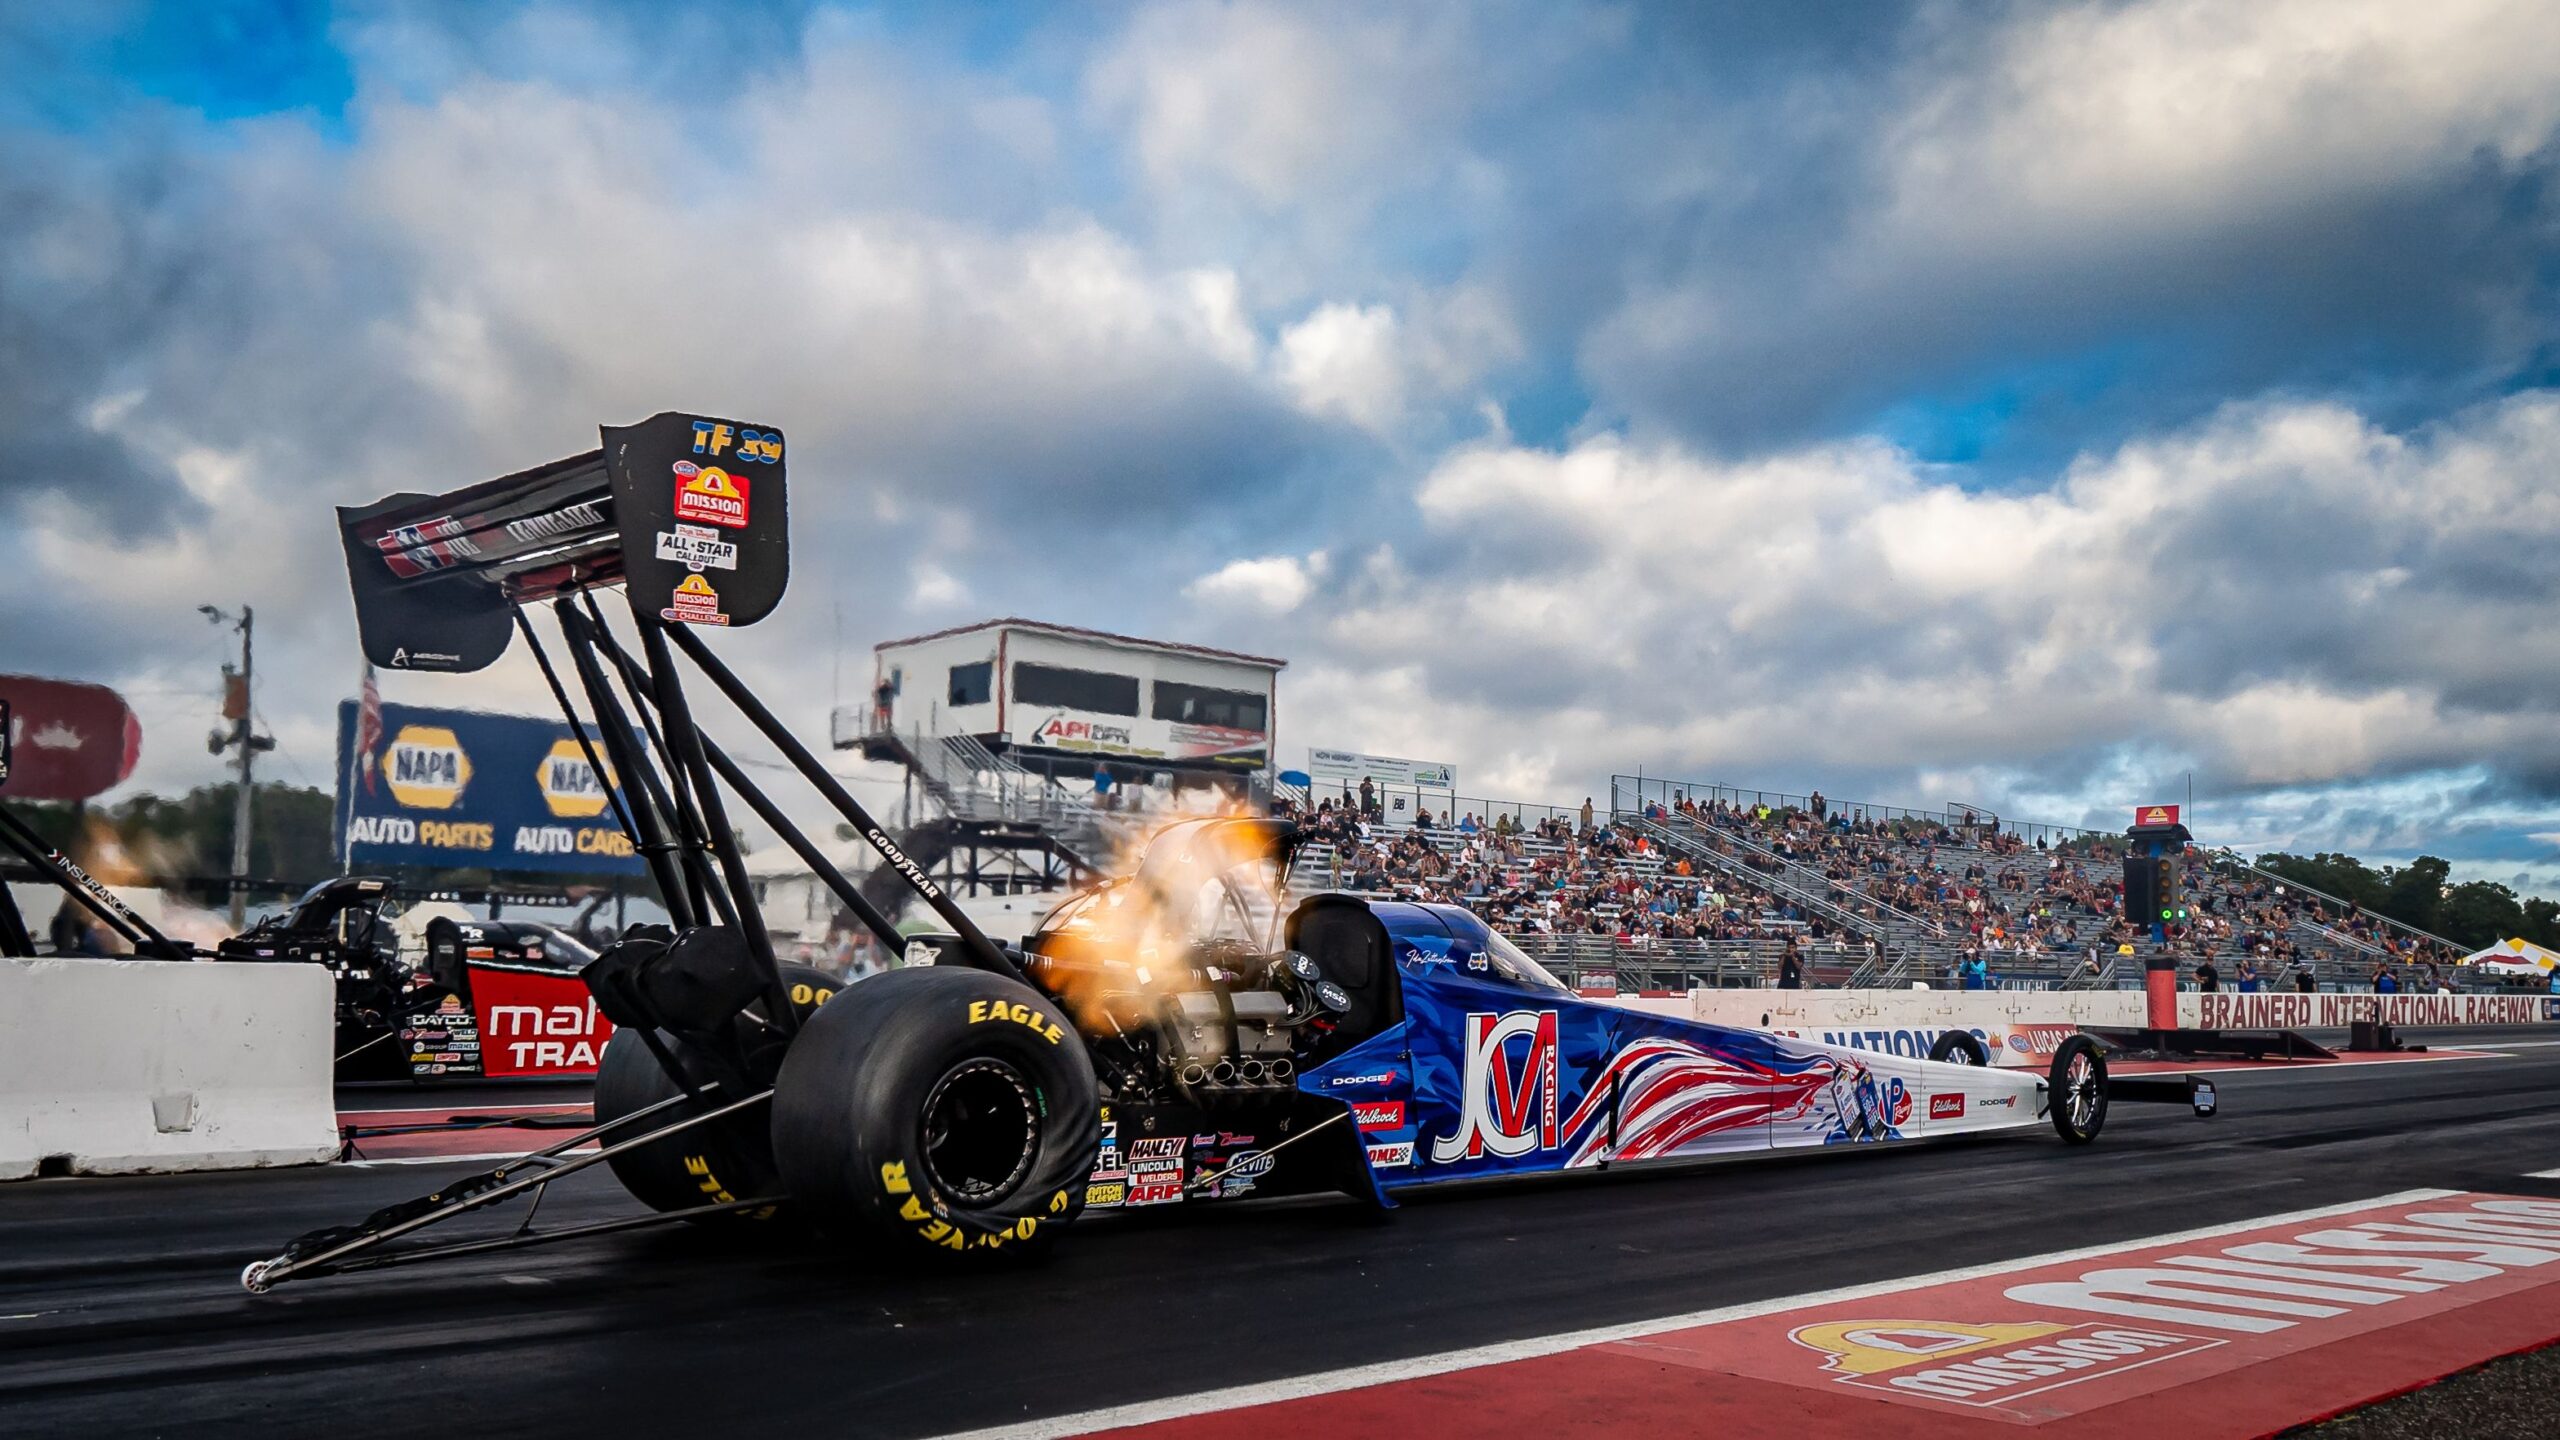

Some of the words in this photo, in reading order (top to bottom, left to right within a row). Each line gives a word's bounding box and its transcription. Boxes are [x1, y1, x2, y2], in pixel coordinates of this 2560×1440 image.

[692, 421, 734, 456] TF
[736, 429, 782, 464] 39
[683, 492, 742, 515] MISSION
[676, 551, 716, 564] CALLOUT
[697, 542, 732, 557] STAR
[676, 593, 715, 605] MISSION
[680, 612, 726, 622] CHALLENGE
[395, 747, 458, 783] NAPA
[351, 817, 415, 843] AUTO
[420, 821, 493, 849] PARTS
[515, 827, 573, 854] AUTO
[868, 829, 939, 898] GOODYEAR
[58, 856, 130, 917] INSURANCE
[1322, 988, 1346, 1004] MSD
[412, 1014, 470, 1025] DAYCO
[968, 1000, 1065, 1045] EAGLE
[2200, 995, 2311, 1029] BRAINERD
[2320, 995, 2460, 1026] INTERNATIONAL
[2466, 996, 2536, 1024] RACEWAY
[508, 1041, 610, 1067] TRA
[2027, 1031, 2065, 1054] LUCAS
[1333, 1075, 1388, 1086] DODGE
[1545, 1045, 1555, 1127] RACING
[1881, 1076, 1904, 1126] VP
[1131, 1140, 1180, 1158] MANLEY
[1368, 1148, 1398, 1163] OMP
[1132, 1161, 1174, 1173] LINCOLN
[1141, 1171, 1178, 1183] WELDERS
[1127, 1184, 1182, 1203] ARP
[1889, 1330, 2188, 1397] MISSION
